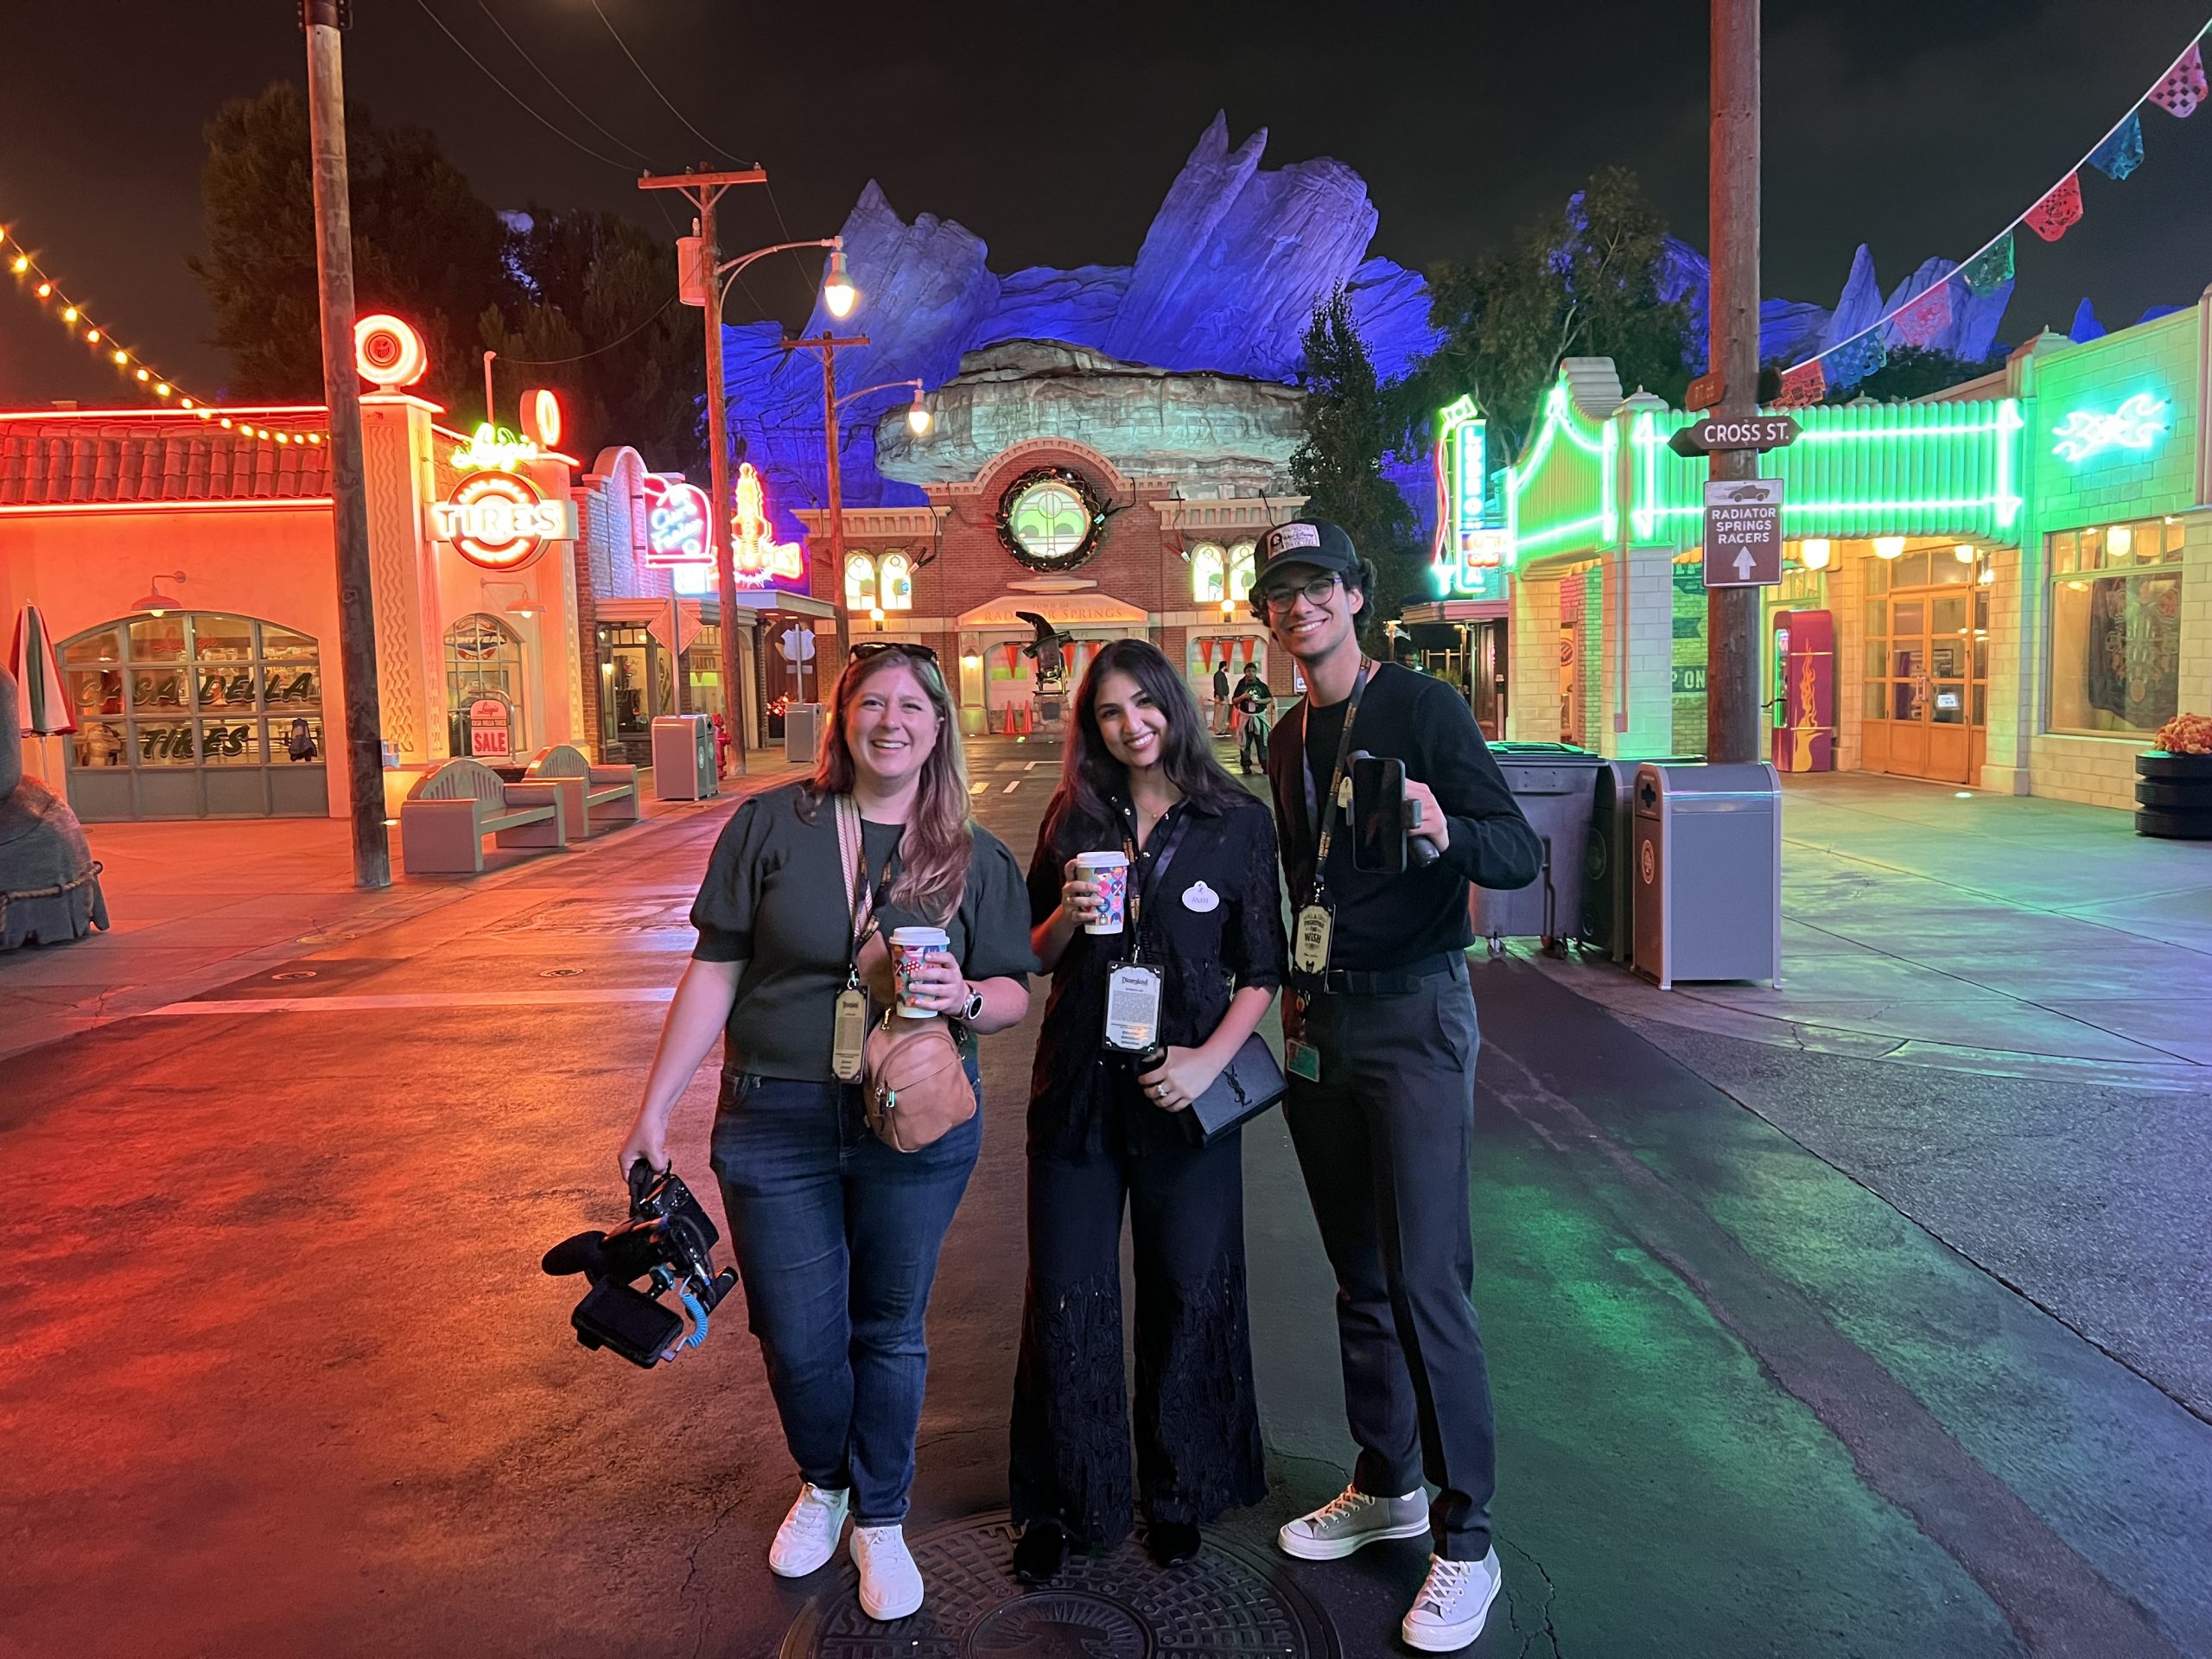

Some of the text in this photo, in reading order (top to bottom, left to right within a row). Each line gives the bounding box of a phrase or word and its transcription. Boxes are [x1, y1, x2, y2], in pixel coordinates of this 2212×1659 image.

[1704, 423, 1789, 442] CROSS ST.
[431, 504, 562, 537] TIRES
[1712, 507, 1777, 520] RADIATOR
[1718, 532, 1770, 544] RACERS
[1064, 607, 1122, 620] SPRINGS
[77, 671, 316, 707] CASA DELLA
[1684, 670, 1706, 689] ON
[143, 723, 251, 758] TIRES
[474, 732, 506, 752] SALE
